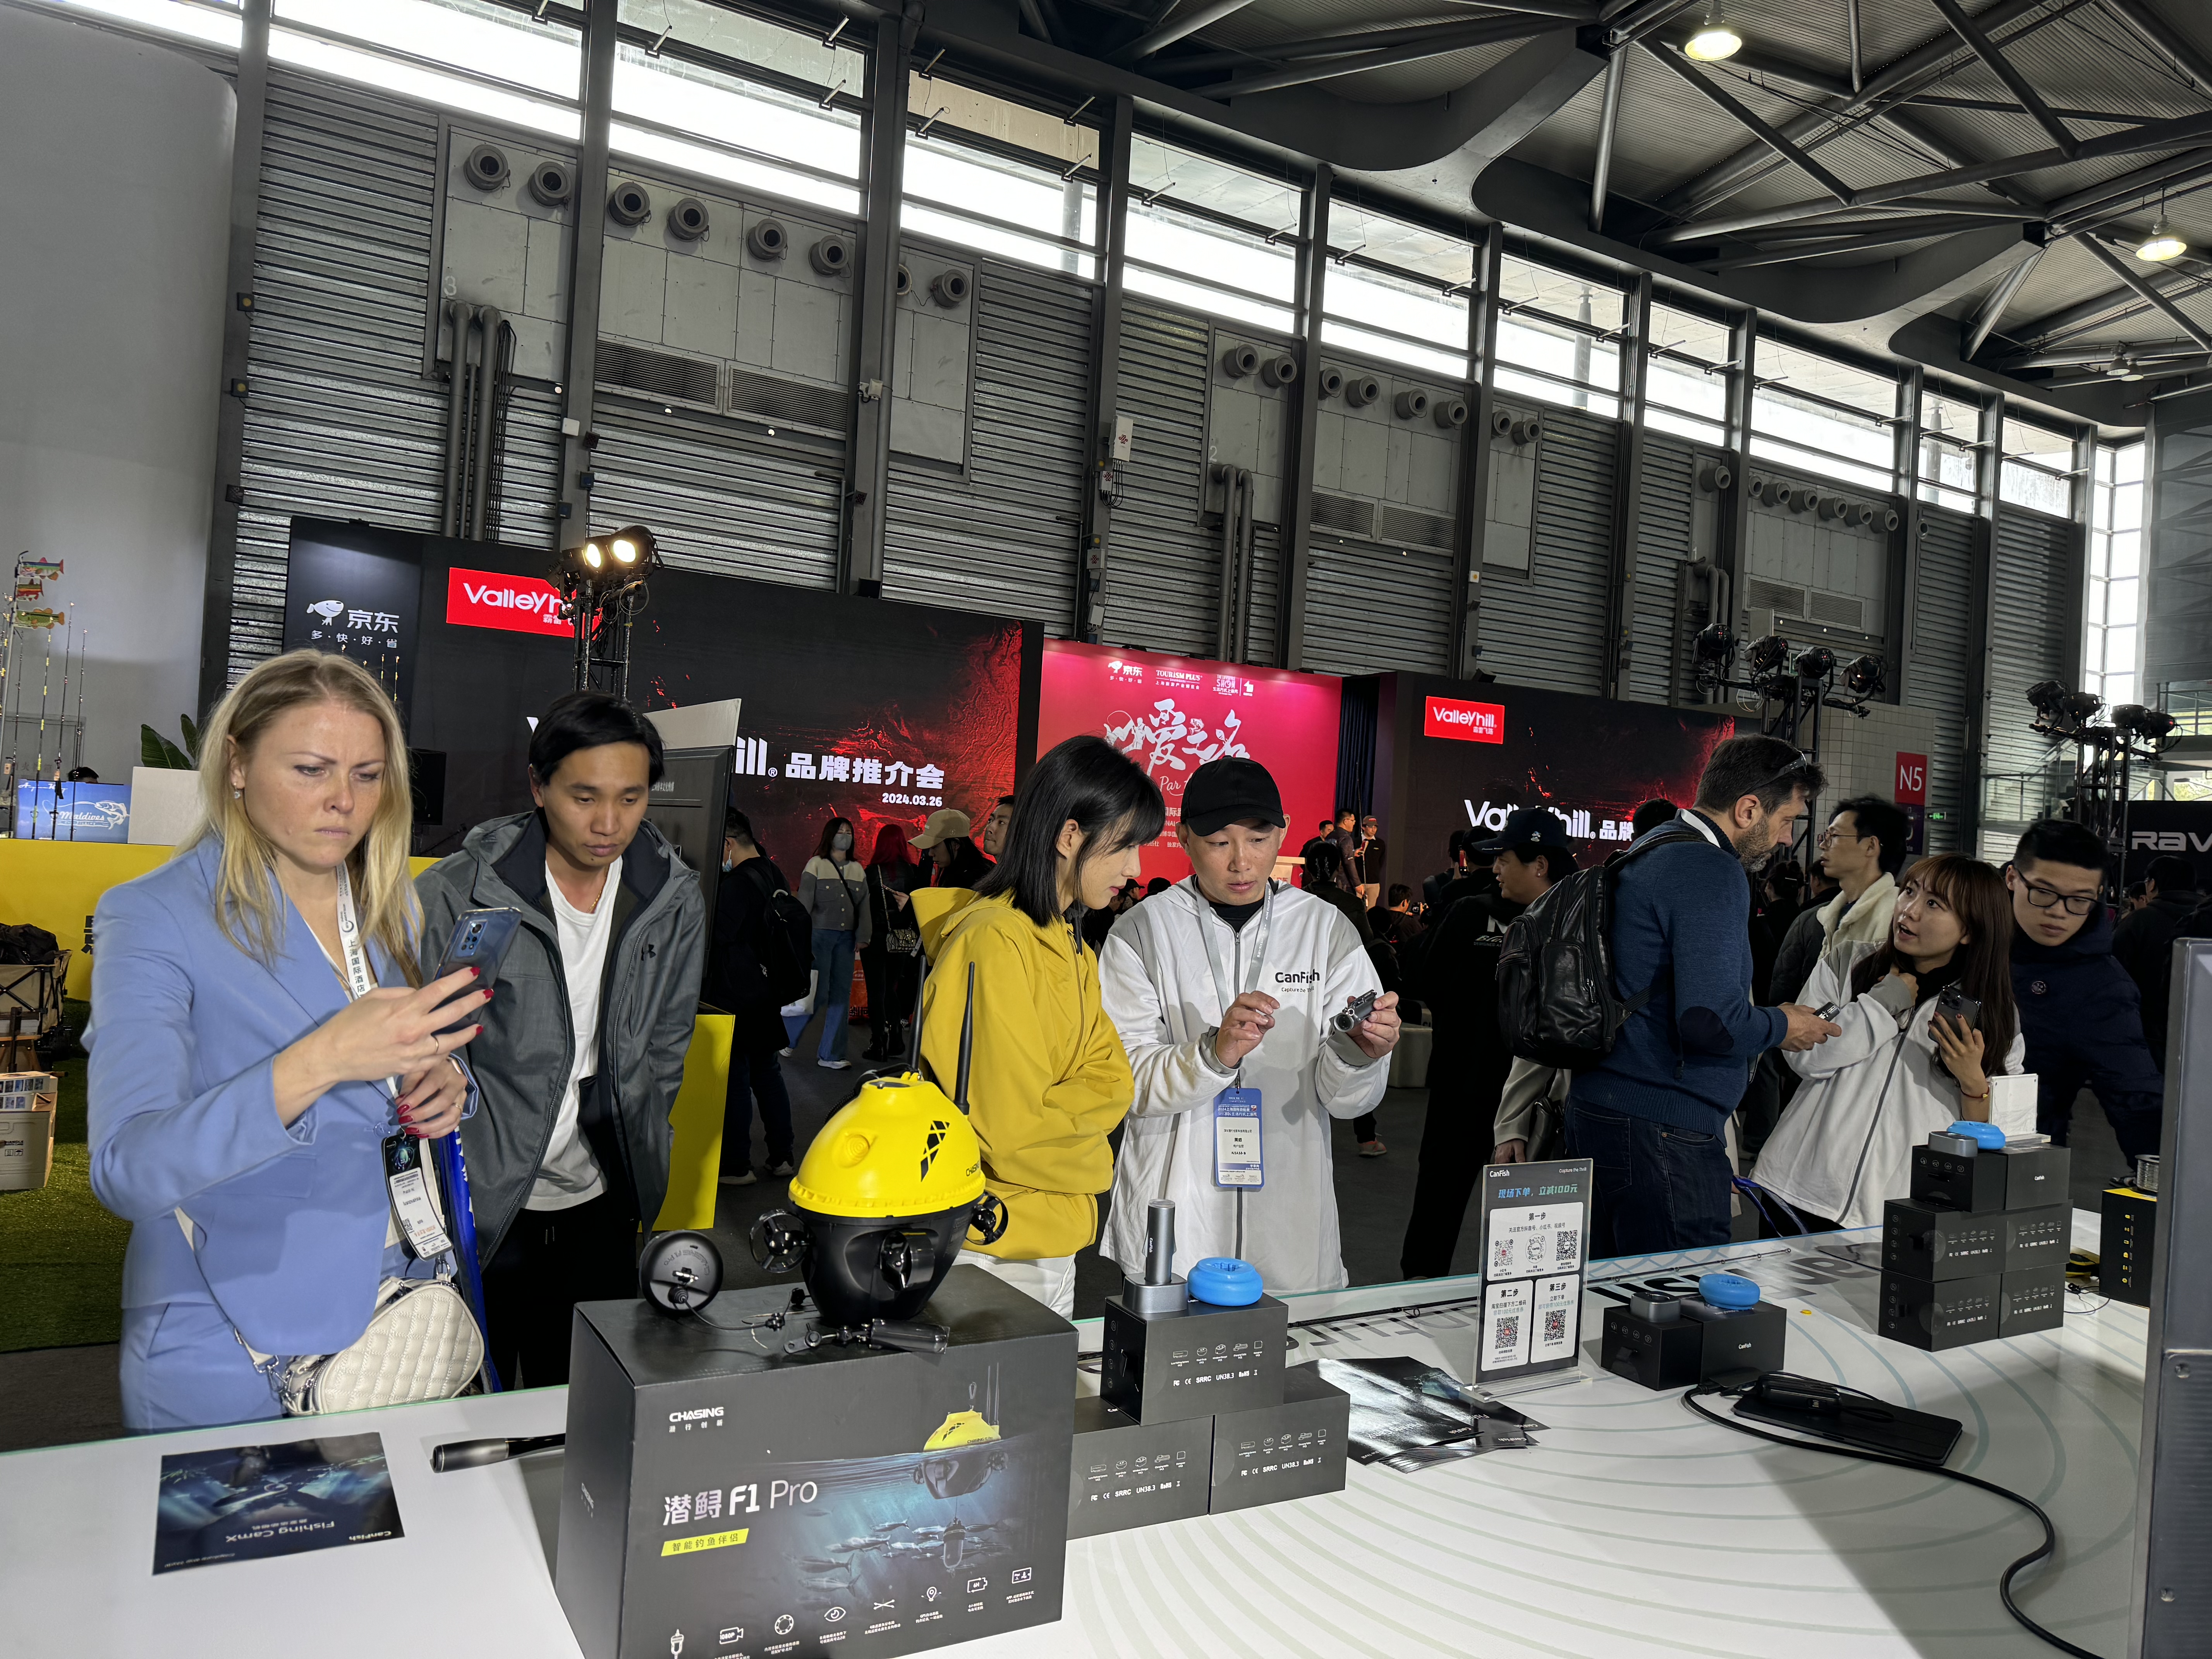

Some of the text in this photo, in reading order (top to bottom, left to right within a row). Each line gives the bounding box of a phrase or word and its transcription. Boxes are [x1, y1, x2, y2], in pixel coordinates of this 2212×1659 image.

[463, 582, 564, 614] Valleyh
[347, 609, 400, 634] 京东
[1123, 665, 1142, 677] 京东
[1433, 707, 1494, 726] Valleyhill
[785, 752, 945, 790] 品牌推介会
[1900, 765, 1922, 791] N5
[882, 792, 943, 807] 2024.03.26
[348, 940, 365, 996] 上海国际酒店
[1275, 969, 1320, 984] CanFish
[1490, 1170, 1510, 1178] CanFish
[1528, 1212, 1546, 1221] 第一步
[1501, 1289, 1518, 1298] 第二步
[1549, 1283, 1566, 1291] 第三步
[1196, 1376, 1212, 1384] SRRC
[1216, 1372, 1234, 1381] UN38.3
[669, 1407, 724, 1422] CHASING
[1282, 1461, 1299, 1469] UN38.3
[1115, 1489, 1131, 1497] SRRC
[1136, 1485, 1156, 1494] UN38.3
[663, 1480, 817, 1526] 潜鲟 F1 Pro
[225, 1521, 335, 1542] Fishing CamX
[348, 1530, 392, 1541] CanFish
[672, 1533, 738, 1552] 智能钓鱼伴侣
[720, 1632, 735, 1640] 1080P
